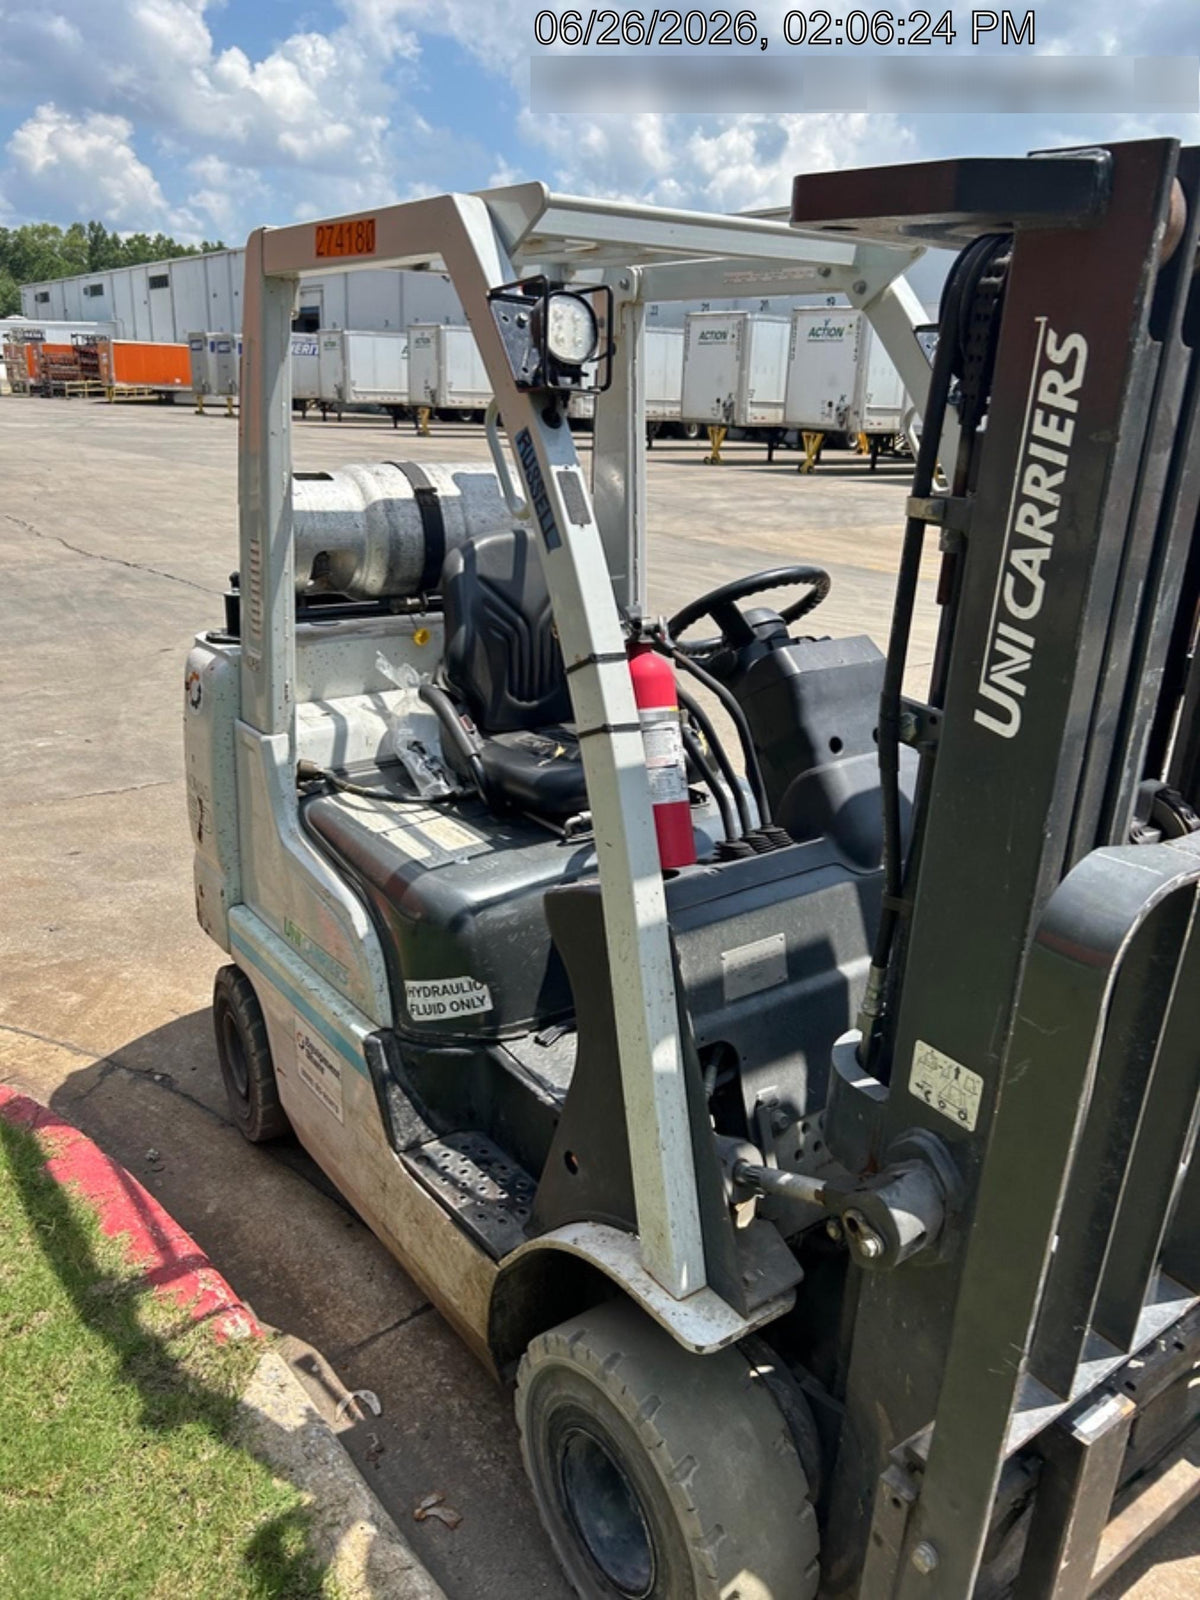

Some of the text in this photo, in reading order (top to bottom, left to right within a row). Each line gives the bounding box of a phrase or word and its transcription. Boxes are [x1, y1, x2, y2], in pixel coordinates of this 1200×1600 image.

[316, 219, 375, 256] 274180
[698, 330, 729, 340] ACTION
[808, 326, 845, 338] ACTION
[973, 322, 1089, 739] UNICARRIERS
[407, 981, 484, 998] HYDRAULIC
[409, 995, 486, 1016] FLUID ONLY
